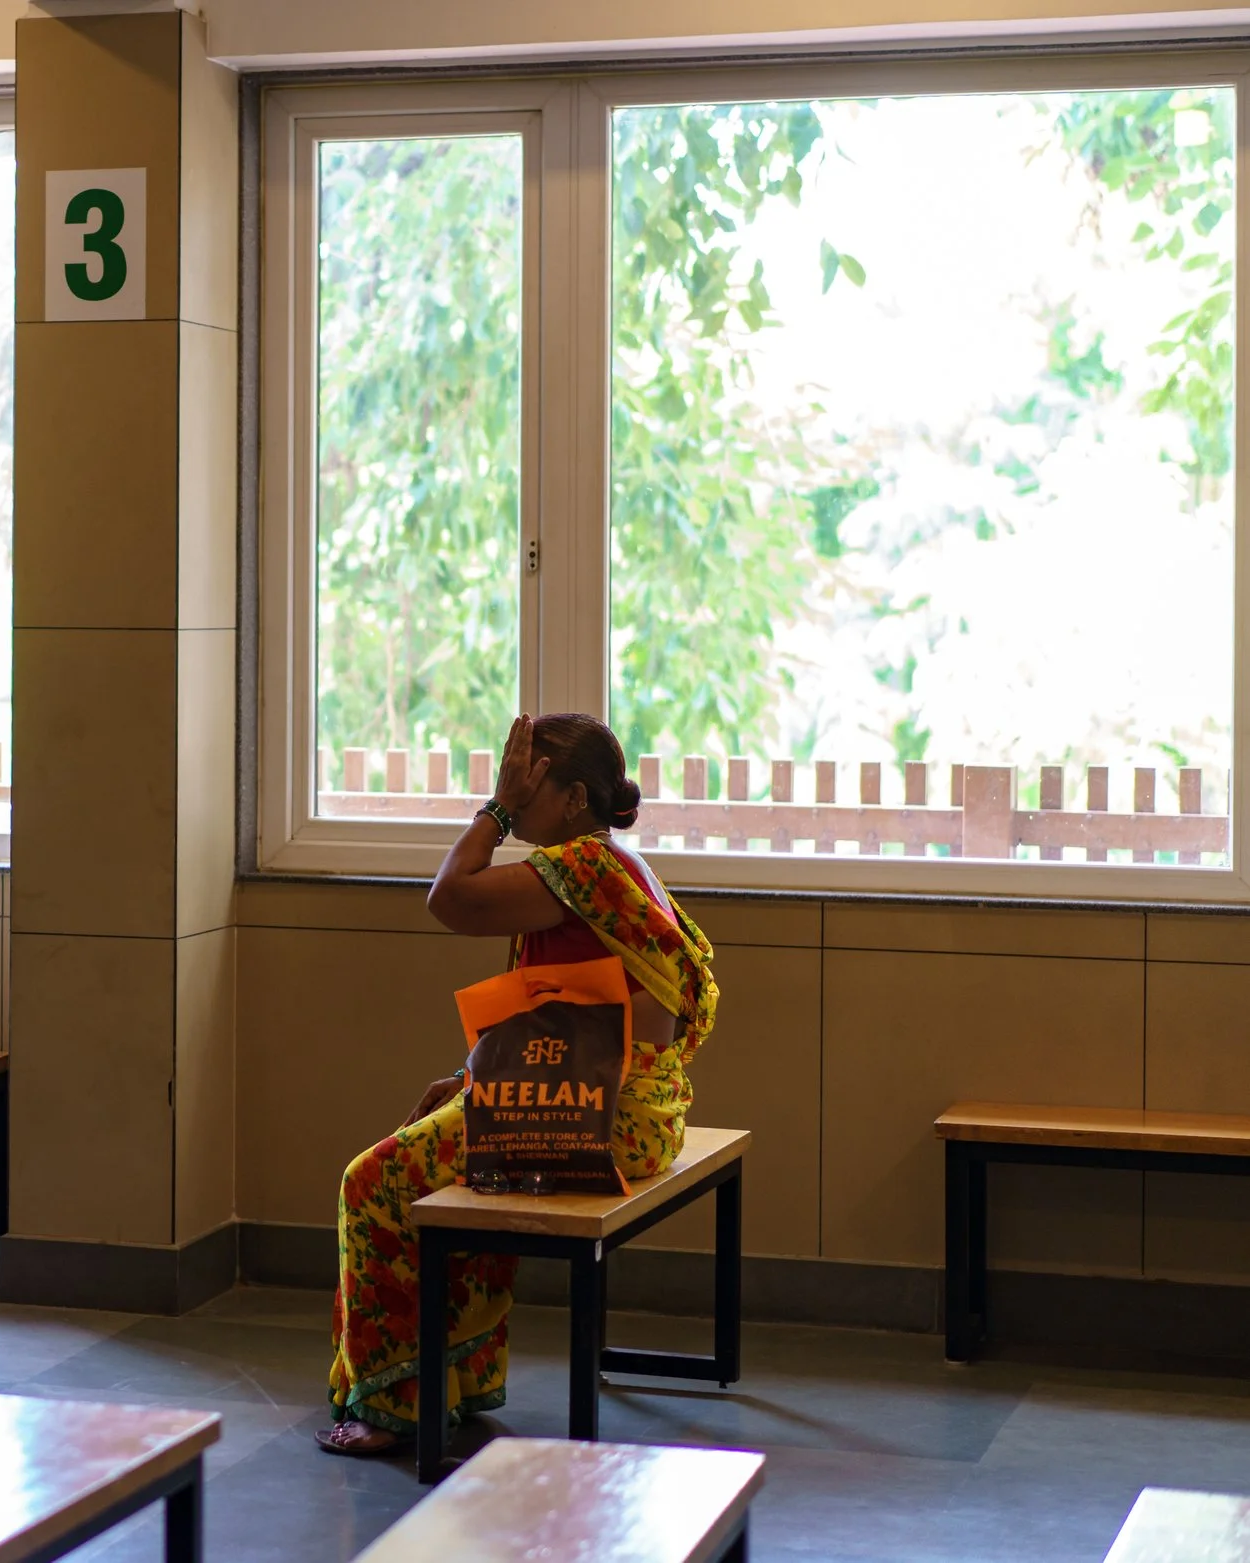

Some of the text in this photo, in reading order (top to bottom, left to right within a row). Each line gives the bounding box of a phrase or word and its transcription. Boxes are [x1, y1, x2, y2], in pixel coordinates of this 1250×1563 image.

[65, 189, 127, 302] 3
[472, 1080, 605, 1111] NEELAM
[493, 1112, 582, 1121] STEP IN STYLE
[479, 1132, 595, 1143] A COMPLETE STORE OF
